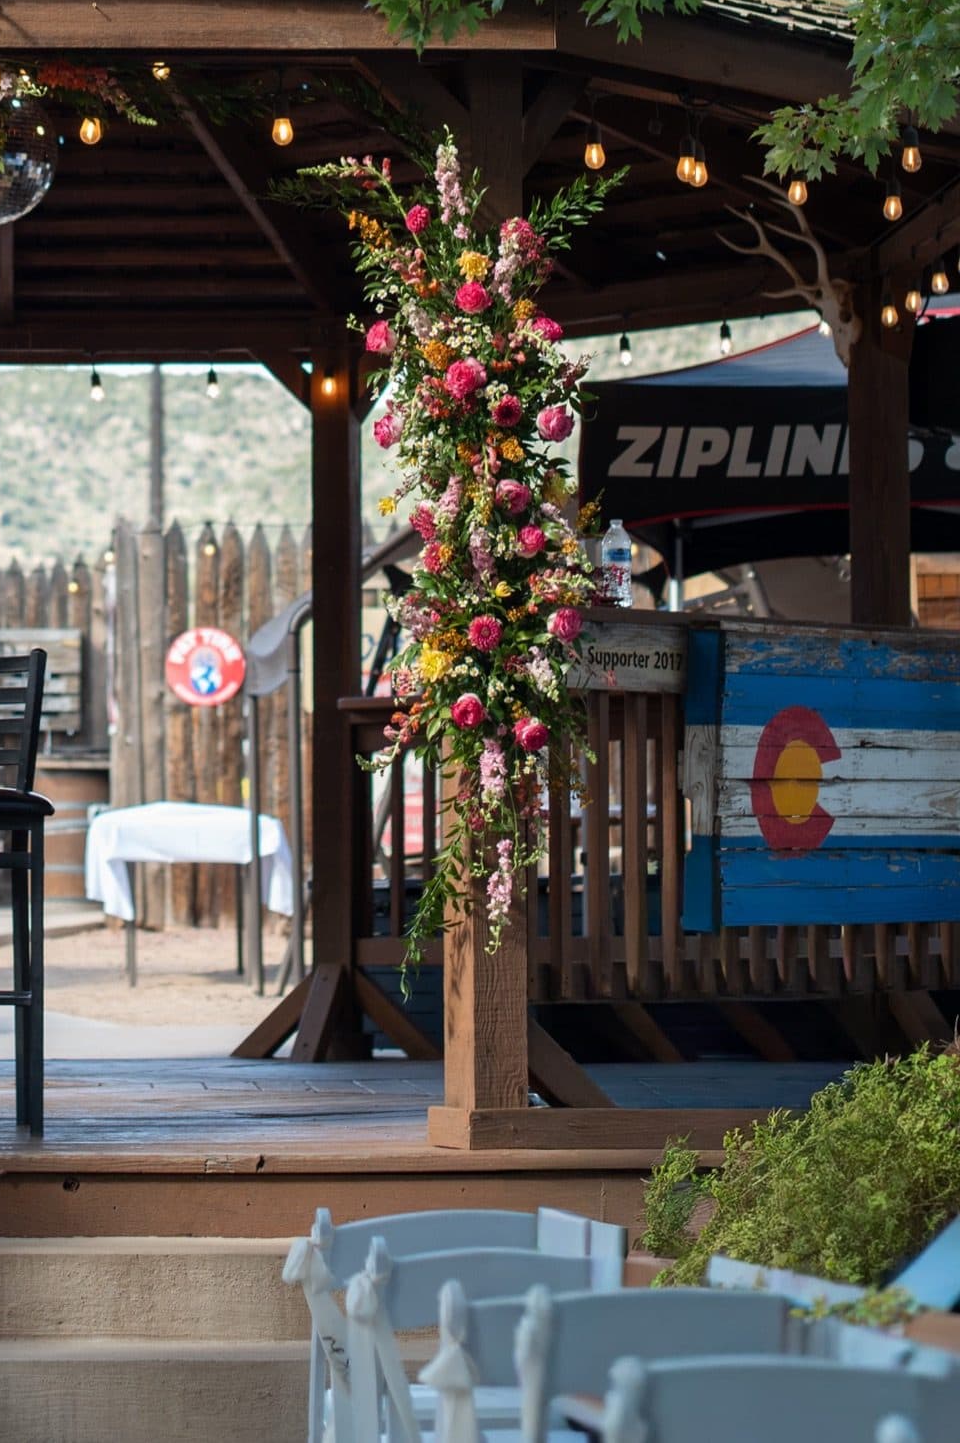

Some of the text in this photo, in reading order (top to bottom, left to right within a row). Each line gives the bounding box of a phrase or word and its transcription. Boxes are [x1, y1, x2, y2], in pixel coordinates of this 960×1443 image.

[607, 423, 925, 478] ZIPLIN
[587, 645, 683, 670] Supporter 2017
